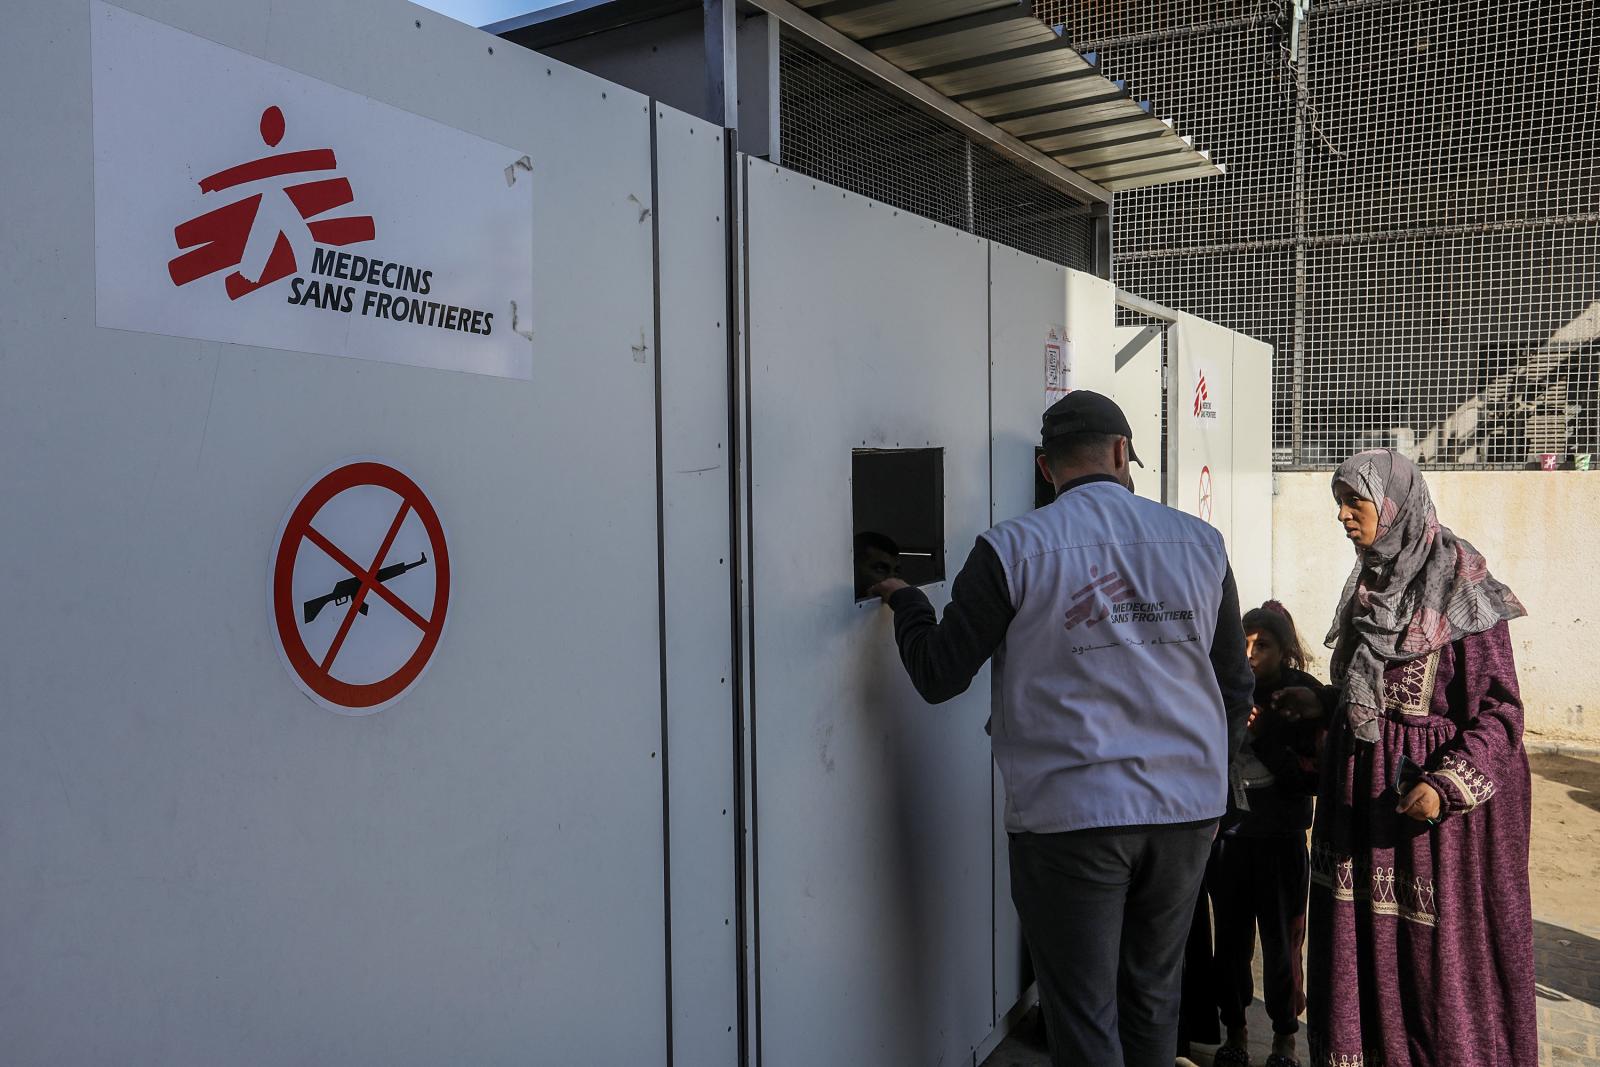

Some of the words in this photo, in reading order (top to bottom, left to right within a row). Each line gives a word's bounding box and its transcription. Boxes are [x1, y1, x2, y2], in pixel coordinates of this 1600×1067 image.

[311, 247, 433, 295] MEDECINS
[287, 277, 356, 313] SANS
[361, 290, 494, 336] FRONTIERES
[1110, 613, 1130, 624] SANS
[1131, 610, 1194, 623] FRONTIERE
[1112, 601, 1165, 614] MEDECINS
